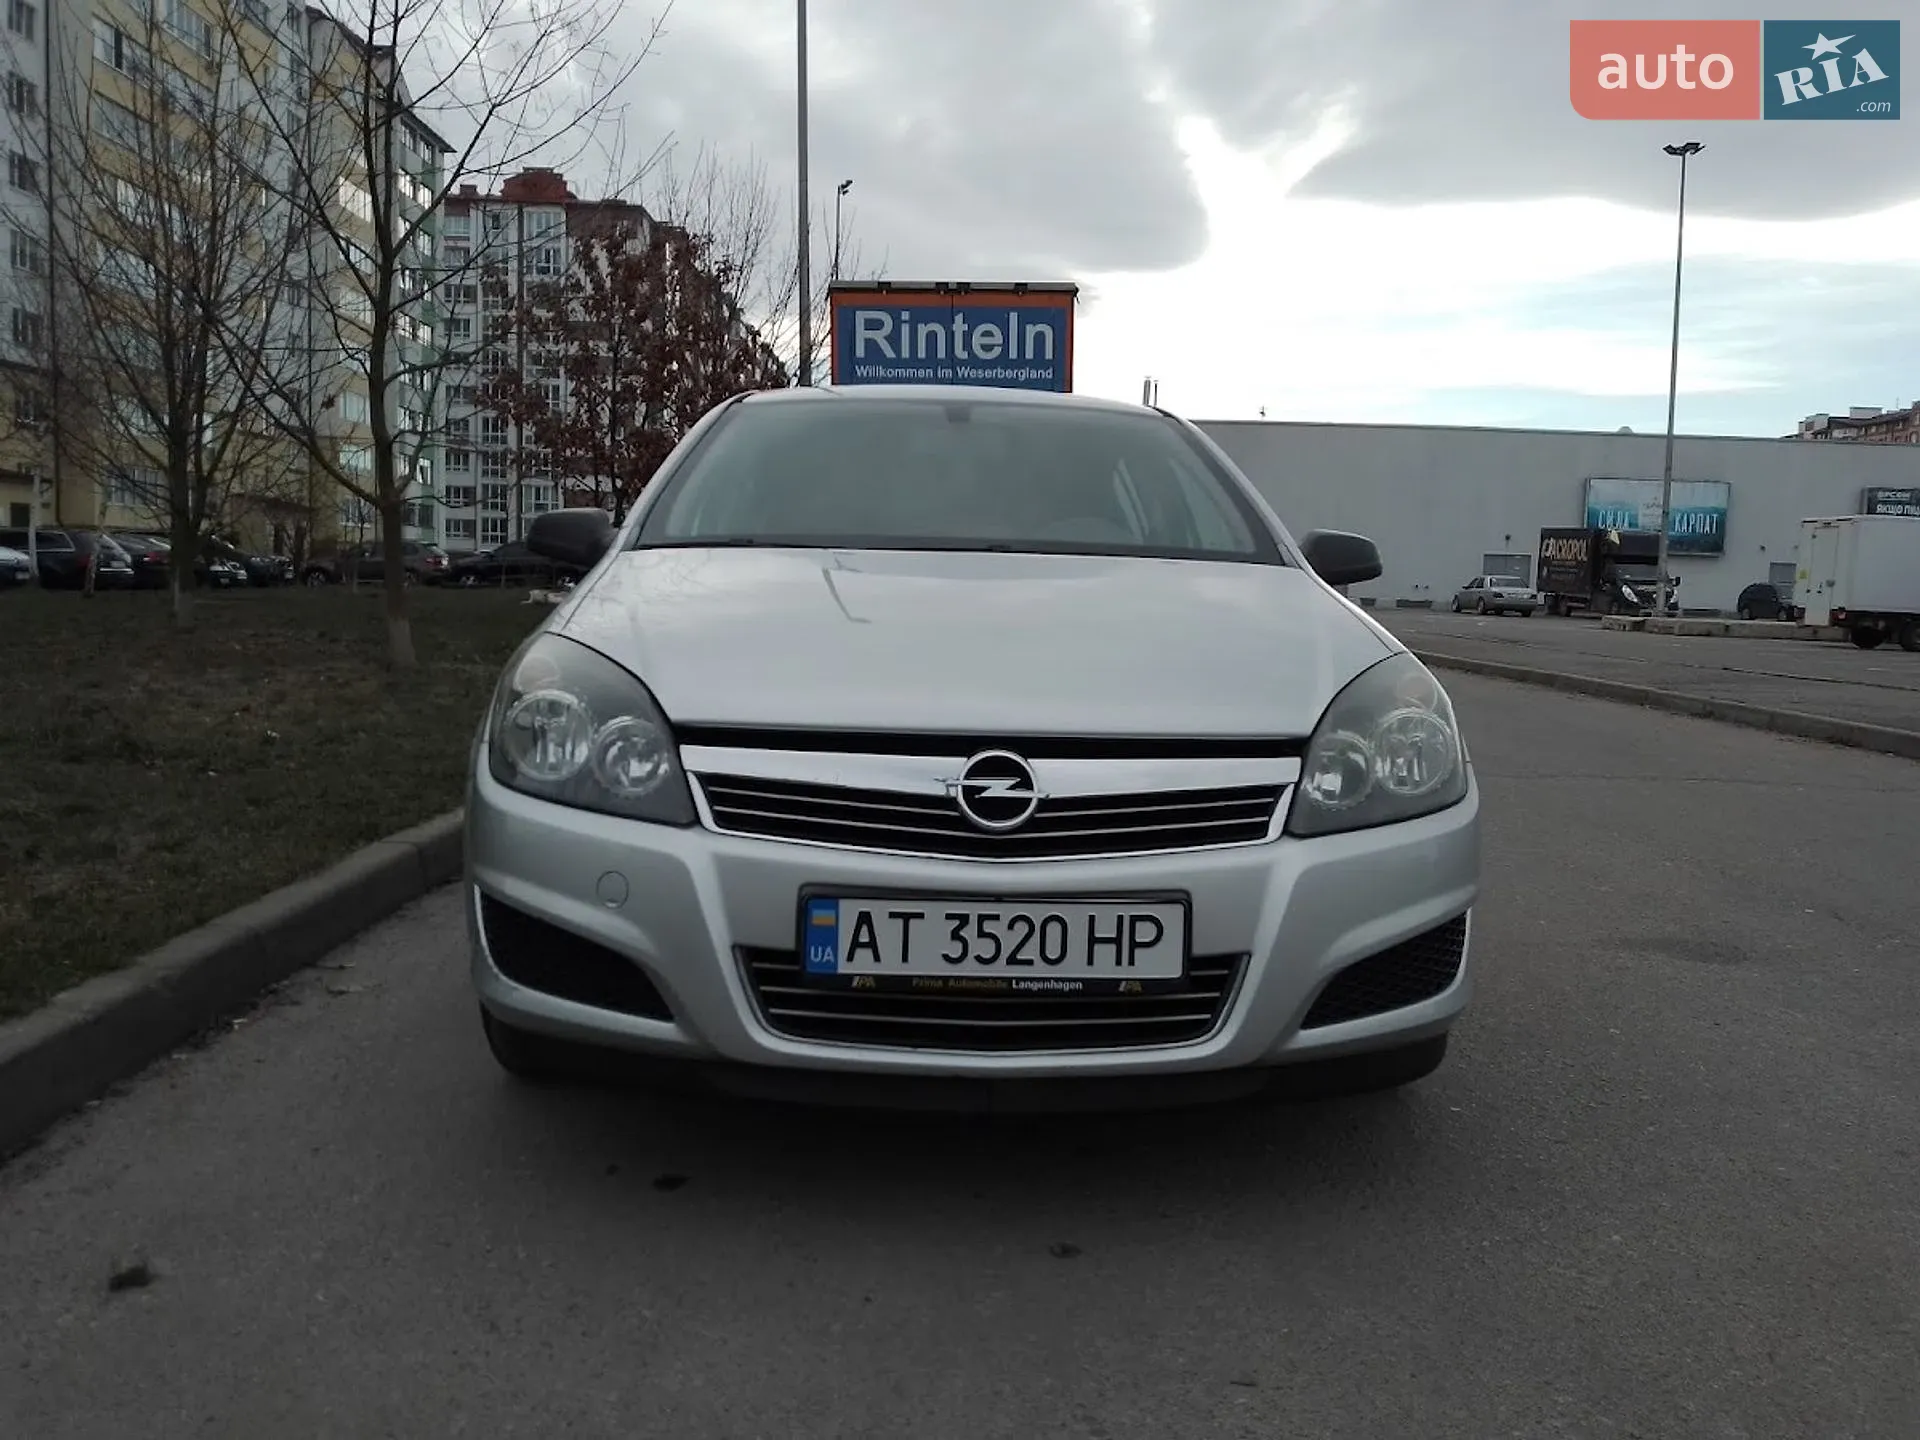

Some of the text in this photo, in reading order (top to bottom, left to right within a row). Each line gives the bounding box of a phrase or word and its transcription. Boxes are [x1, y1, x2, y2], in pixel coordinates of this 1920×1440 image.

[854, 309, 1054, 361] Rinteln
[855, 365, 934, 379] Willkommen
[956, 365, 1053, 381] Weserbergland
[1674, 512, 1718, 534] КАРПАТ
[846, 911, 1164, 966] AT 3520 HP
[810, 946, 834, 962] UA
[1011, 979, 1083, 992] Langenhagen
